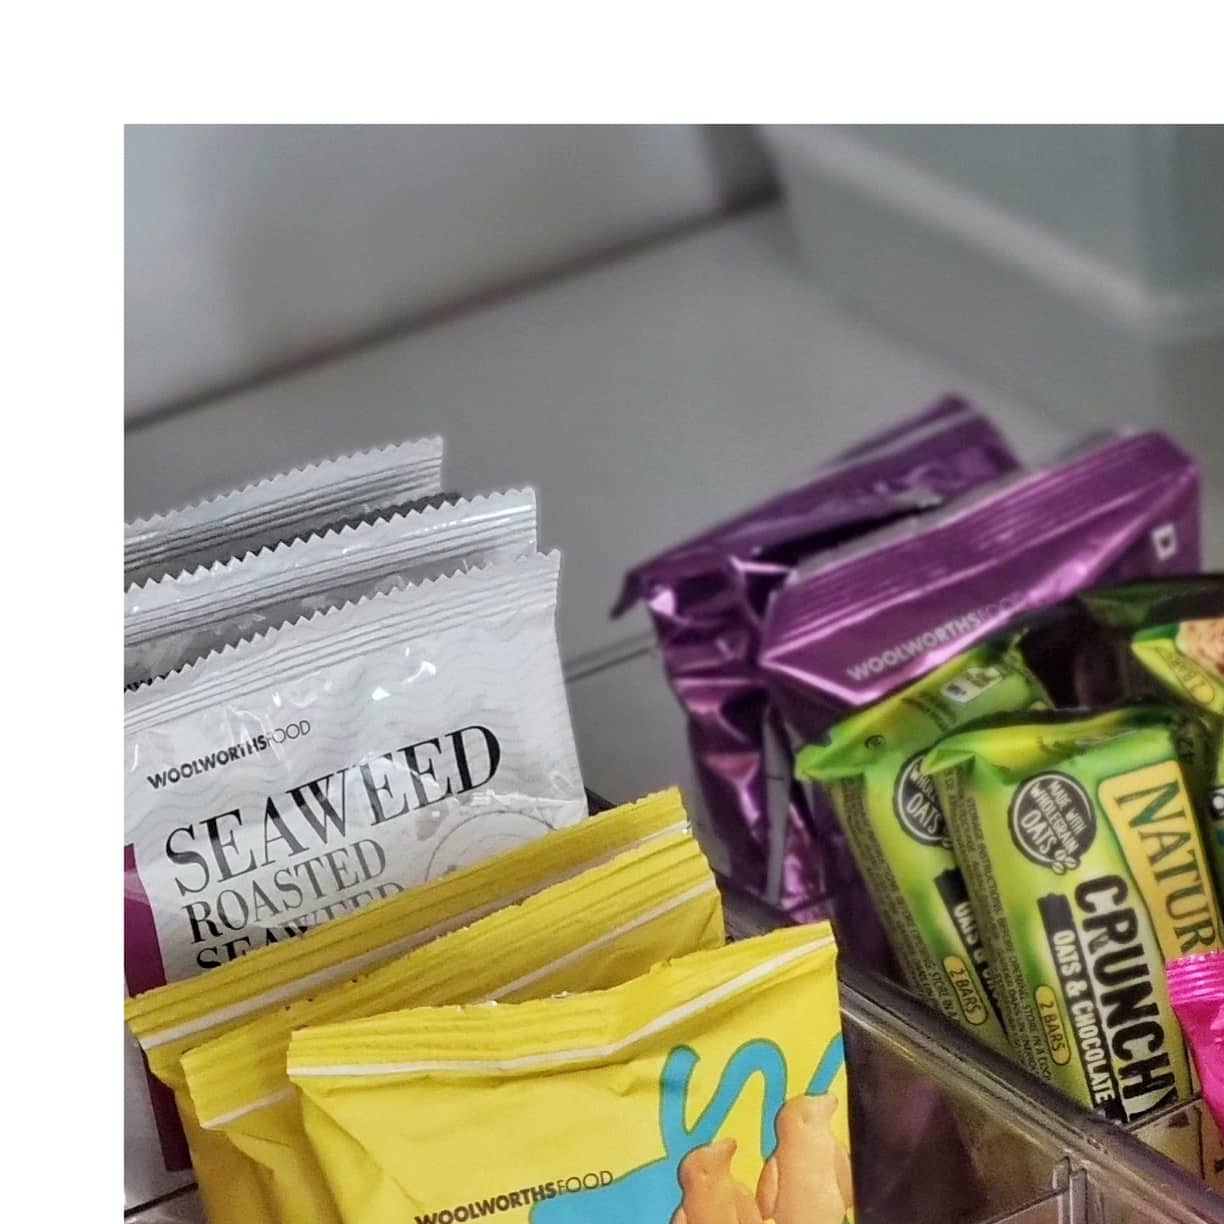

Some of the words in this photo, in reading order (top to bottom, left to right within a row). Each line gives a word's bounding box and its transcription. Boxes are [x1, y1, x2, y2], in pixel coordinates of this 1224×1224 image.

[846, 593, 1022, 682] WOOLWORTHSFOO
[146, 719, 312, 790] WOOLWORTHSFOOD
[165, 724, 502, 897] SEAWEED
[907, 793, 940, 834] OATS
[1021, 810, 1057, 854] OATS
[1030, 783, 1079, 854] WHOLEGRAIN
[1048, 780, 1072, 810] MADE
[1065, 808, 1087, 835] WITH
[182, 837, 388, 945] ROASTED
[1113, 778, 1217, 953] NATUR
[949, 968, 964, 978] 2
[1053, 929, 1082, 976] OATS
[955, 980, 982, 1014] BARS
[1039, 999, 1054, 1010] 2
[1066, 980, 1087, 998] &
[1043, 1014, 1066, 1052] BARS
[1071, 1000, 1115, 1104] CHOCOLATE
